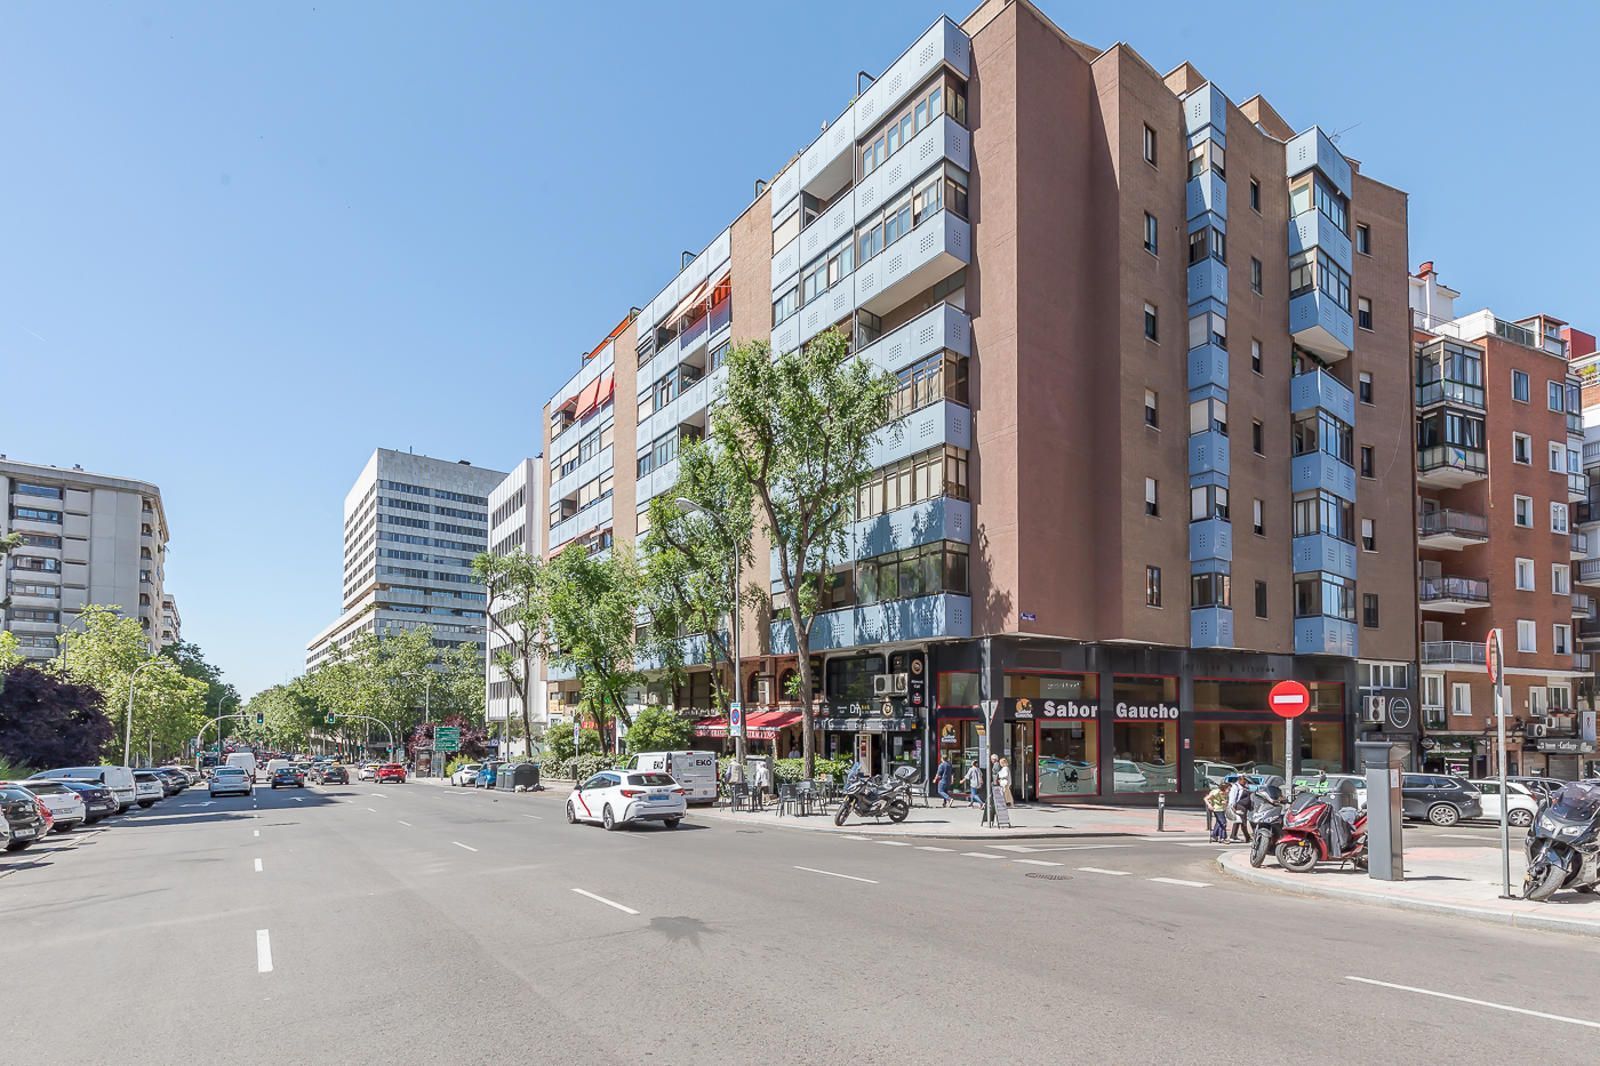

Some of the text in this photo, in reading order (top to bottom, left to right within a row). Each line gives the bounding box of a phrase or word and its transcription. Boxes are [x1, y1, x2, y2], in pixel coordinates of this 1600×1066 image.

[1043, 700, 1179, 719] Sabor Gaucho
[653, 760, 664, 770] EKO
[695, 759, 712, 767] EKO
